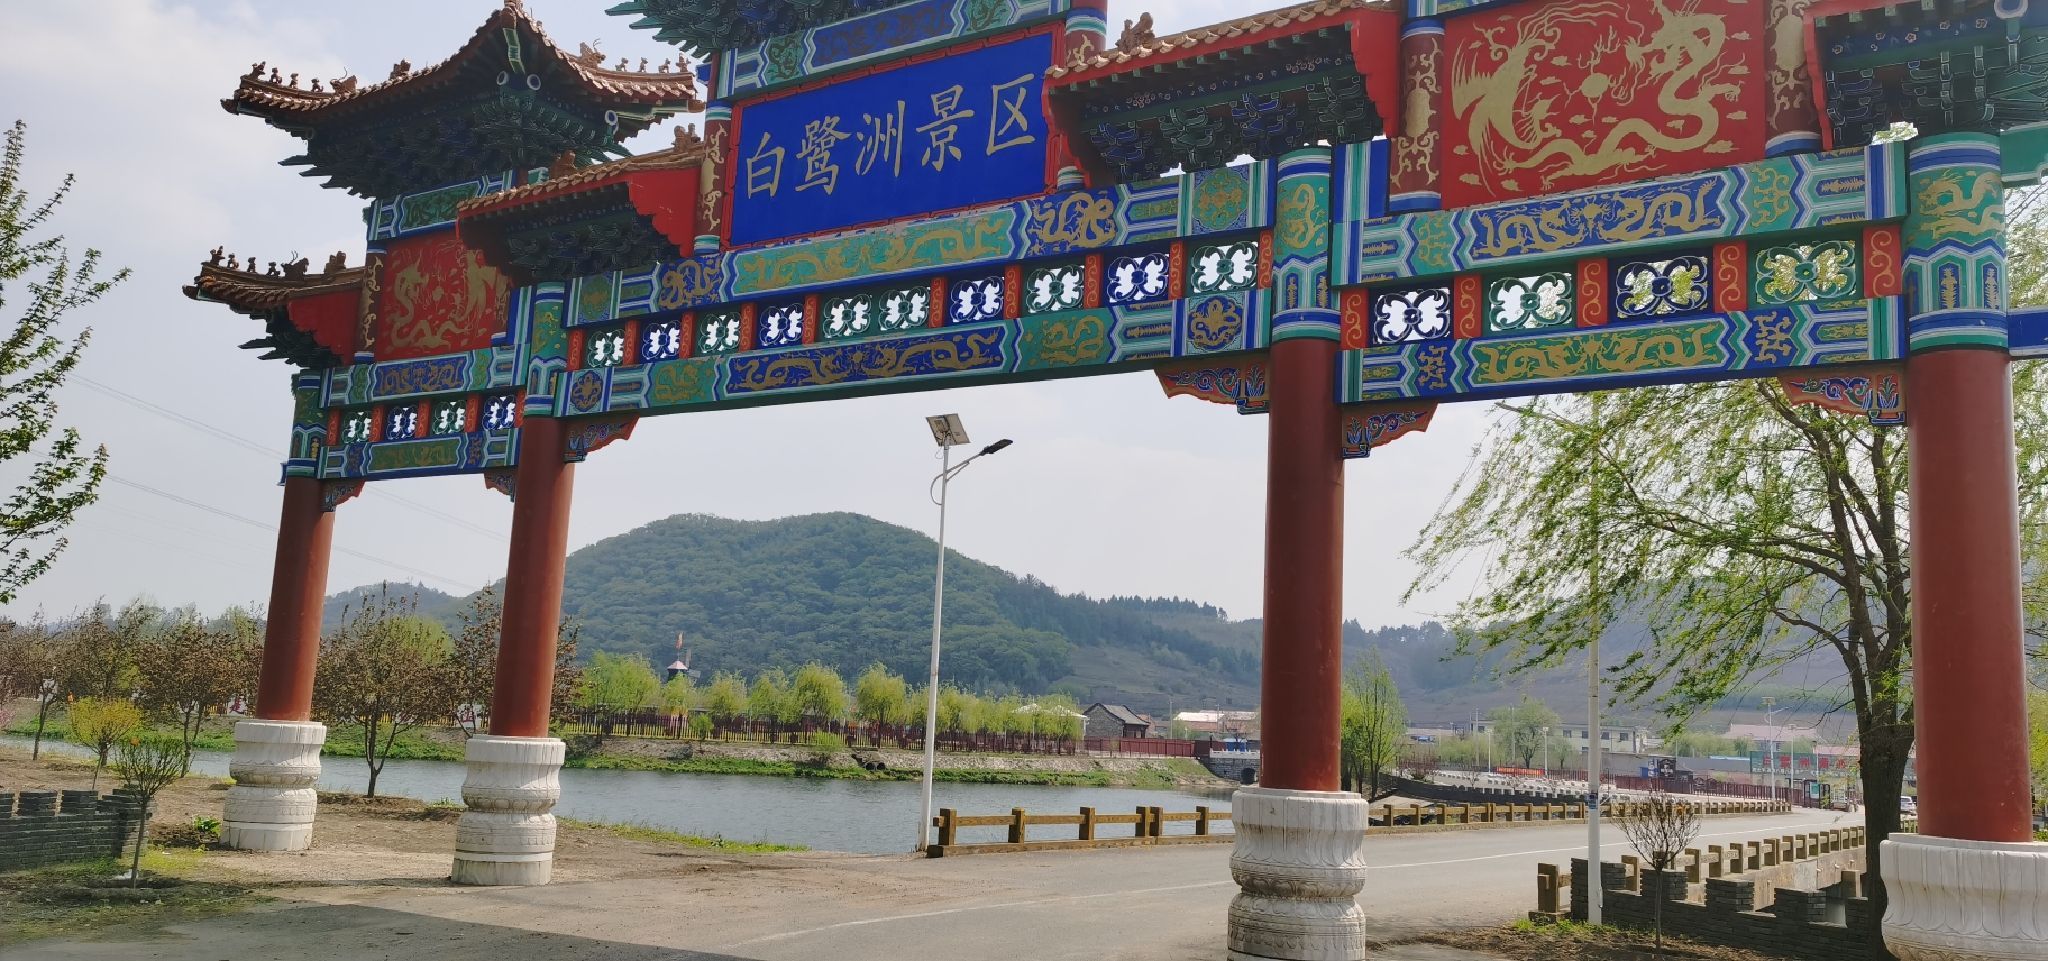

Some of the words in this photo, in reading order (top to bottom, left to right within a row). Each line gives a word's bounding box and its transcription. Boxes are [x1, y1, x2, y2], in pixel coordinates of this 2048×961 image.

[746, 73, 1035, 199] 白鹭洲景区
